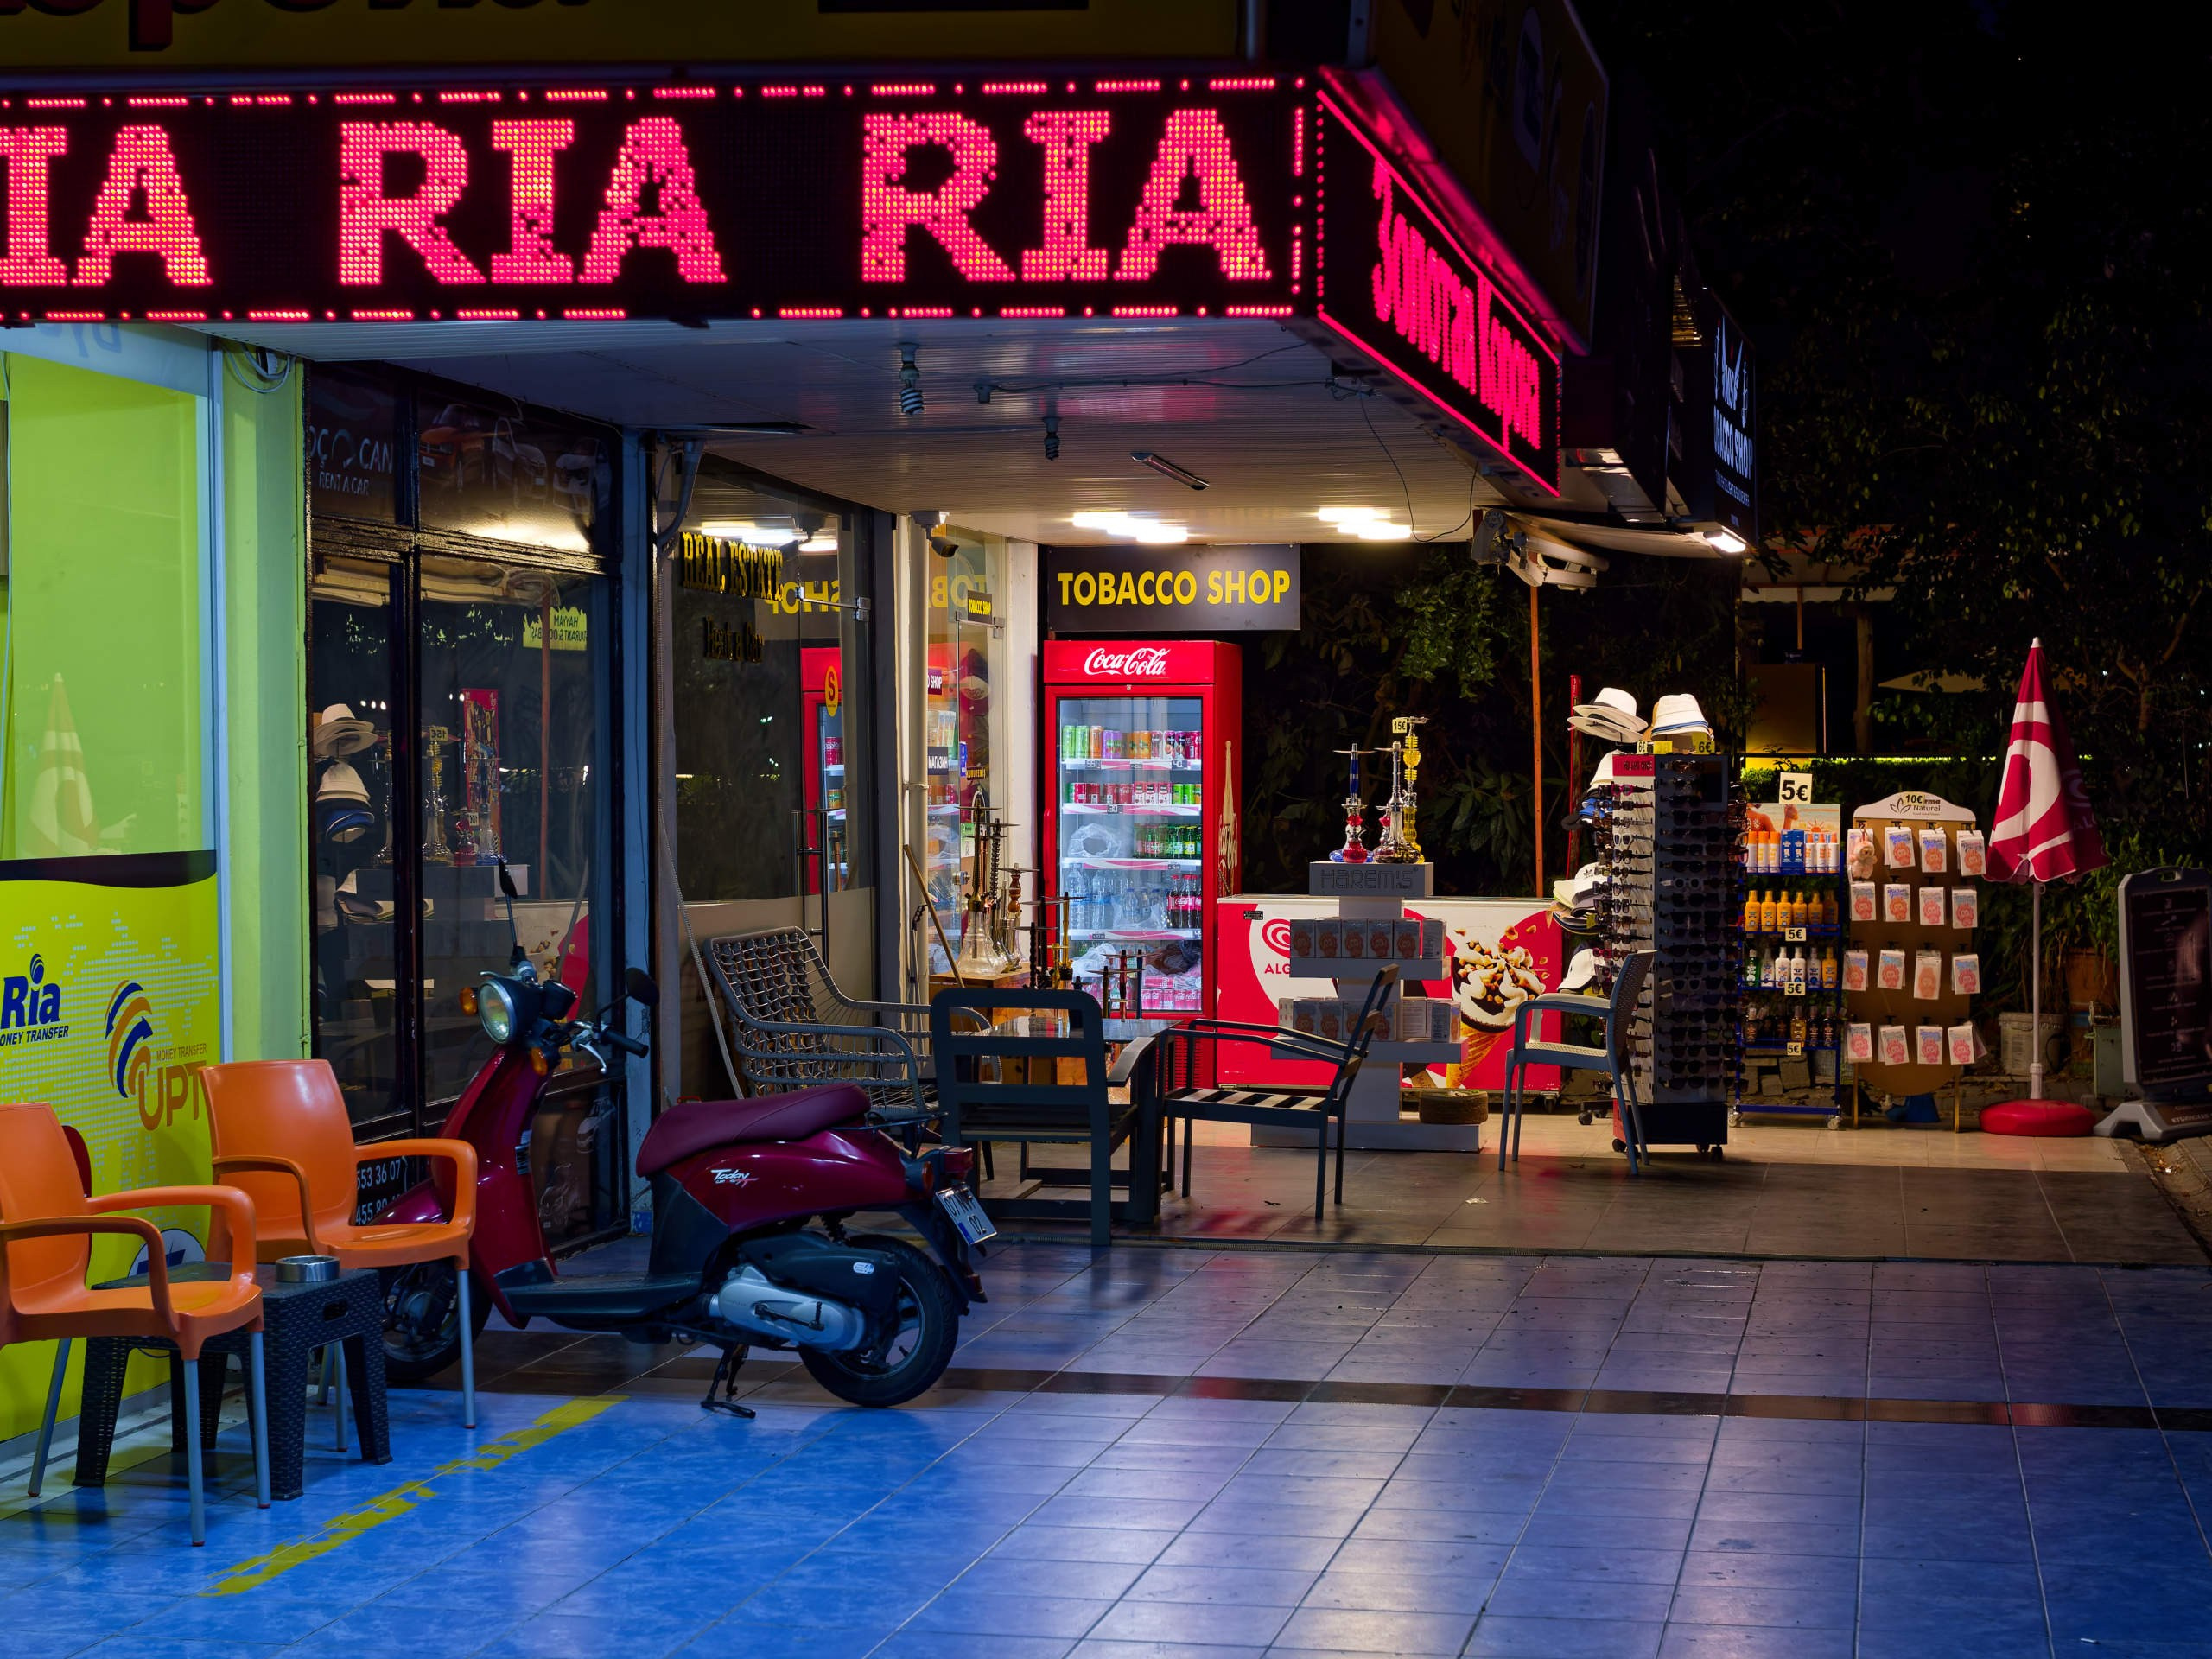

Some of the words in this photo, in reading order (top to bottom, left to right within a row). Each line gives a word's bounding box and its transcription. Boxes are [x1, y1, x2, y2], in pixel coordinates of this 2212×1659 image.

[339, 117, 728, 285] RIA
[861, 108, 1273, 283] RIA
[1735, 428, 1754, 480] SHOP
[318, 471, 340, 492] RENT
[342, 475, 350, 493] A
[351, 476, 370, 497] CAR
[681, 531, 726, 594] REAL
[728, 541, 784, 601] ESTATE
[1057, 570, 1198, 606] TOBACCO
[1206, 569, 1292, 605] SHOP
[1084, 647, 1172, 676] Coca-Cola
[1394, 721, 1406, 731] 15€
[1698, 741, 1712, 753] 6€
[1781, 779, 1808, 802] 5€
[1905, 794, 1923, 804] 10€
[1788, 929, 1803, 939] 5€
[0, 954, 61, 1030] Ria
[1787, 983, 1802, 994] 5€
[26, 1026, 69, 1042] TRANSFER
[156, 1047, 176, 1062] MONEY
[178, 1043, 207, 1058] TRANSFER
[1788, 1045, 1800, 1053] 5€
[138, 1060, 207, 1131] UPT
[375, 1162, 387, 1185] 36
[389, 1158, 402, 1181] 07
[710, 1168, 750, 1183] Today
